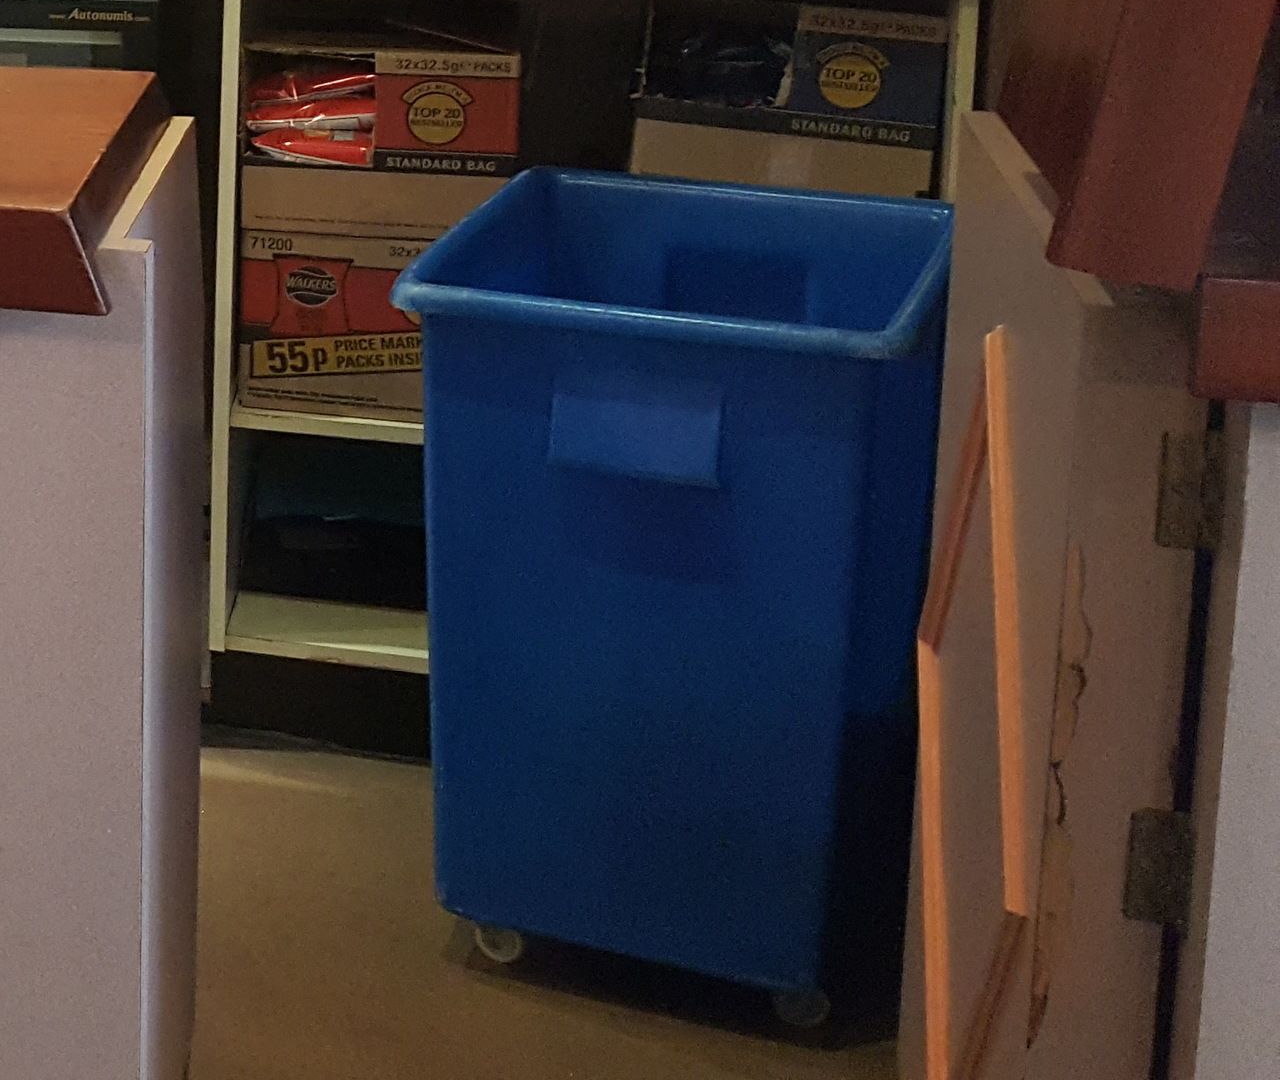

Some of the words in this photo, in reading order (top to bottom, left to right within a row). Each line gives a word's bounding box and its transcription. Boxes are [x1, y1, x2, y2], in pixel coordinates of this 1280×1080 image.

[824, 67, 855, 81] TOP
[859, 71, 878, 83] 20
[412, 106, 442, 119] TOP
[443, 106, 461, 119] 20
[792, 119, 873, 140] STANDARD
[877, 128, 911, 143] BAG
[385, 156, 462, 171] STANDARD
[466, 160, 497, 172] BAG
[249, 236, 293, 251] 71200
[287, 275, 337, 291] WALKERS
[333, 338, 378, 352] PRICE
[265, 340, 329, 373] 55p
[335, 354, 385, 369] PACKS
